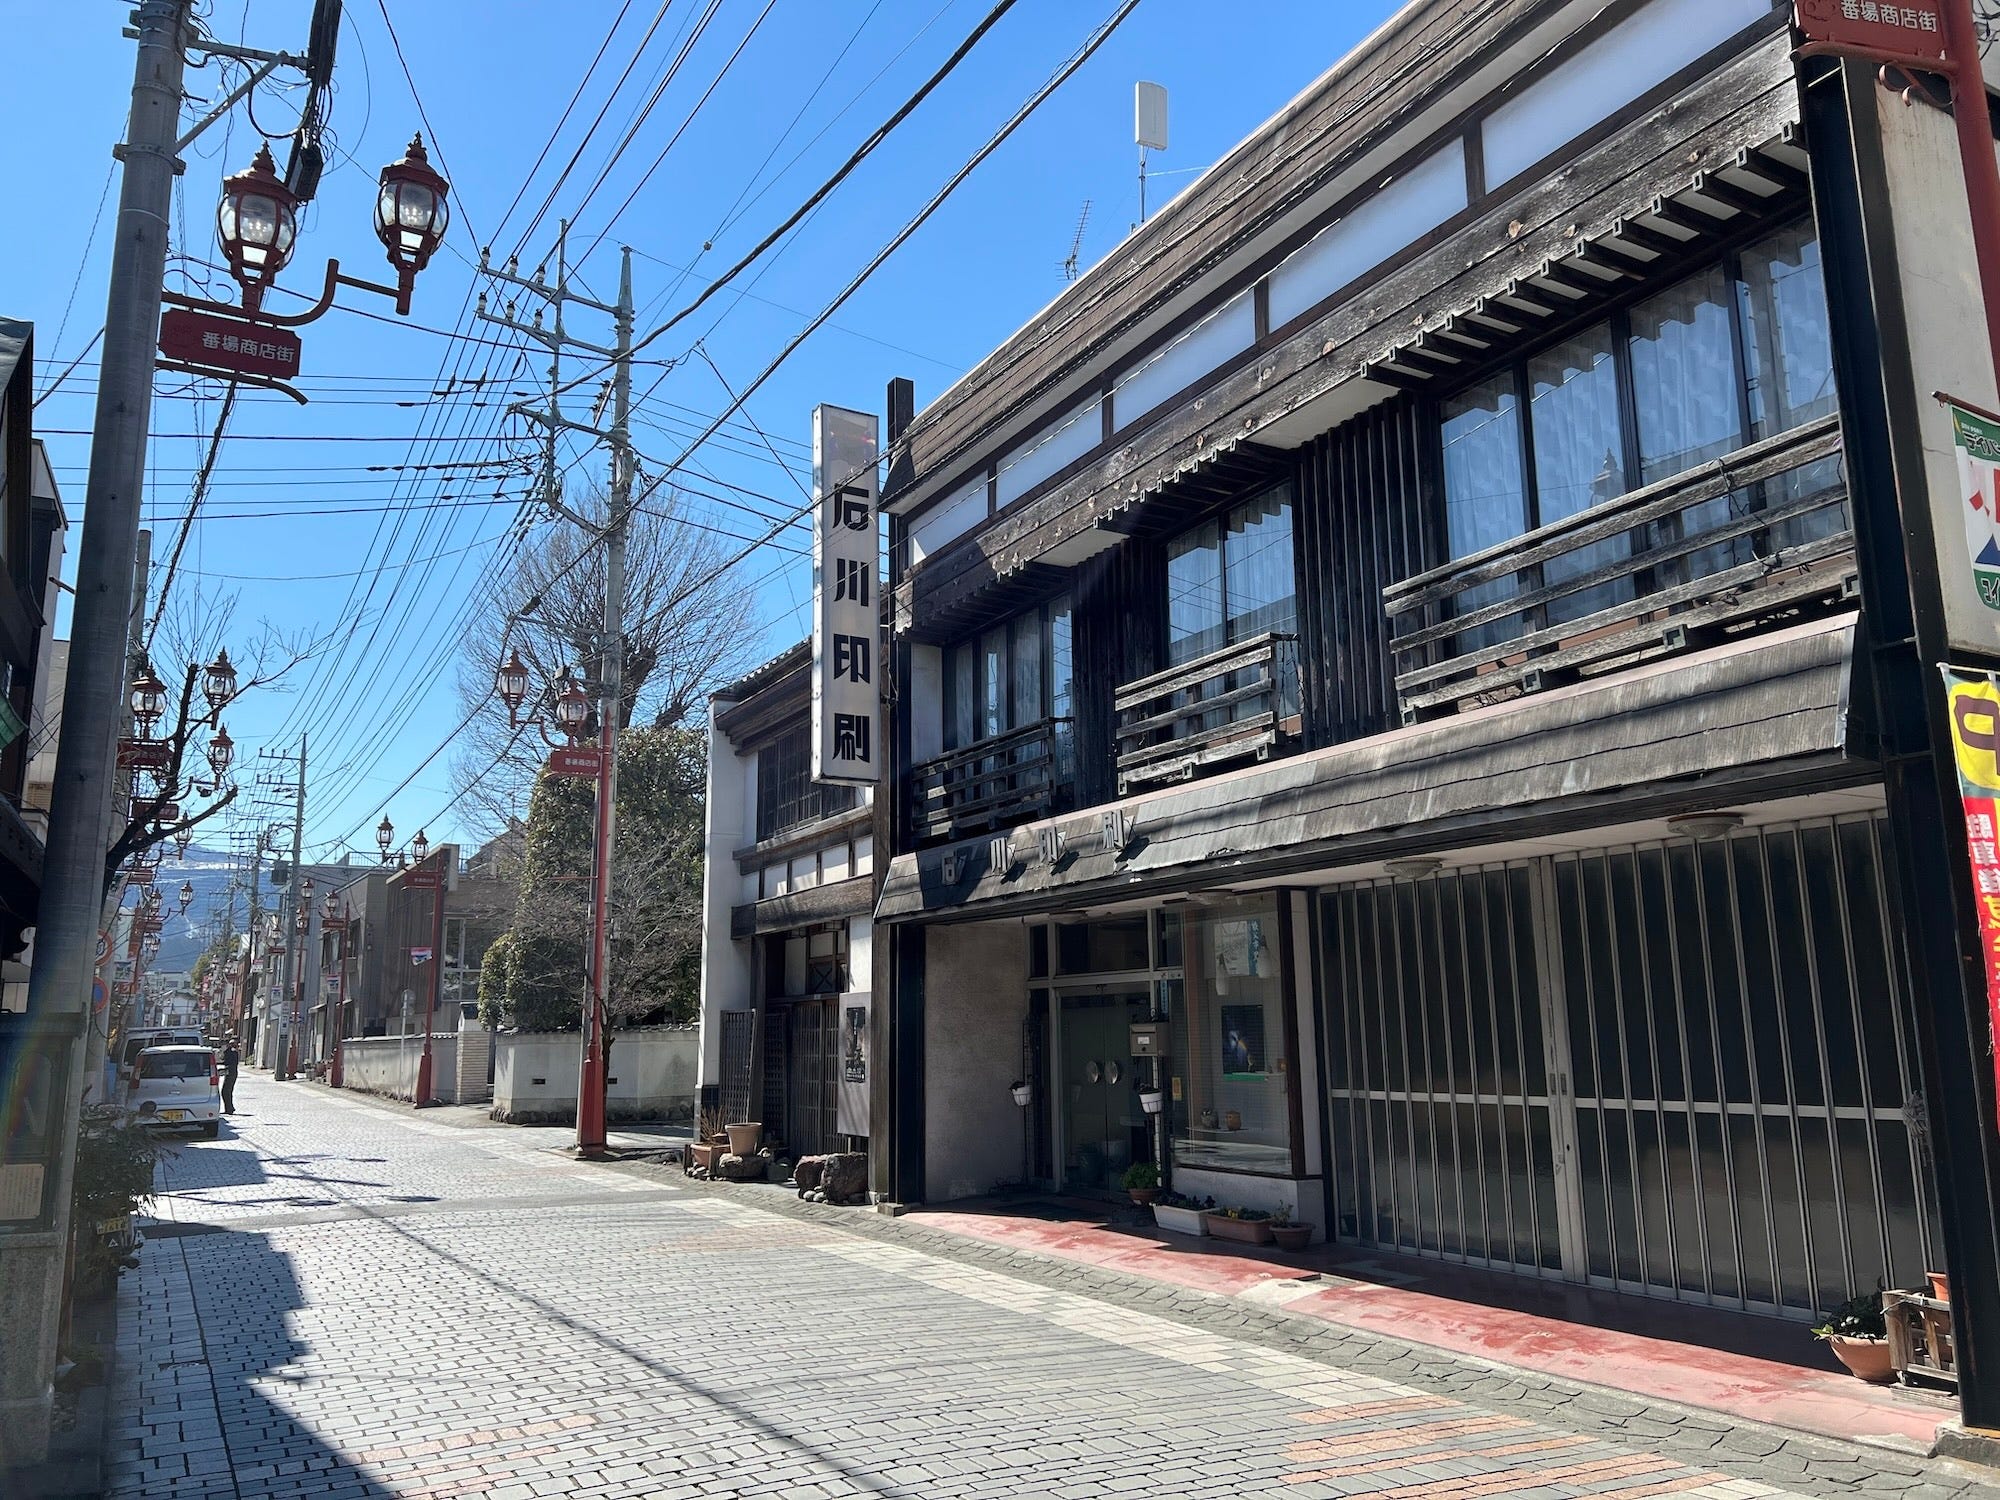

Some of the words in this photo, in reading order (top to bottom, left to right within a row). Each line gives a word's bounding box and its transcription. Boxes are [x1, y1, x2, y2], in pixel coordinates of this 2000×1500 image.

[1840, 0, 1937, 32] 番場商店街
[202, 331, 295, 364] 番場商店街
[832, 482, 870, 764] 石川印刷
